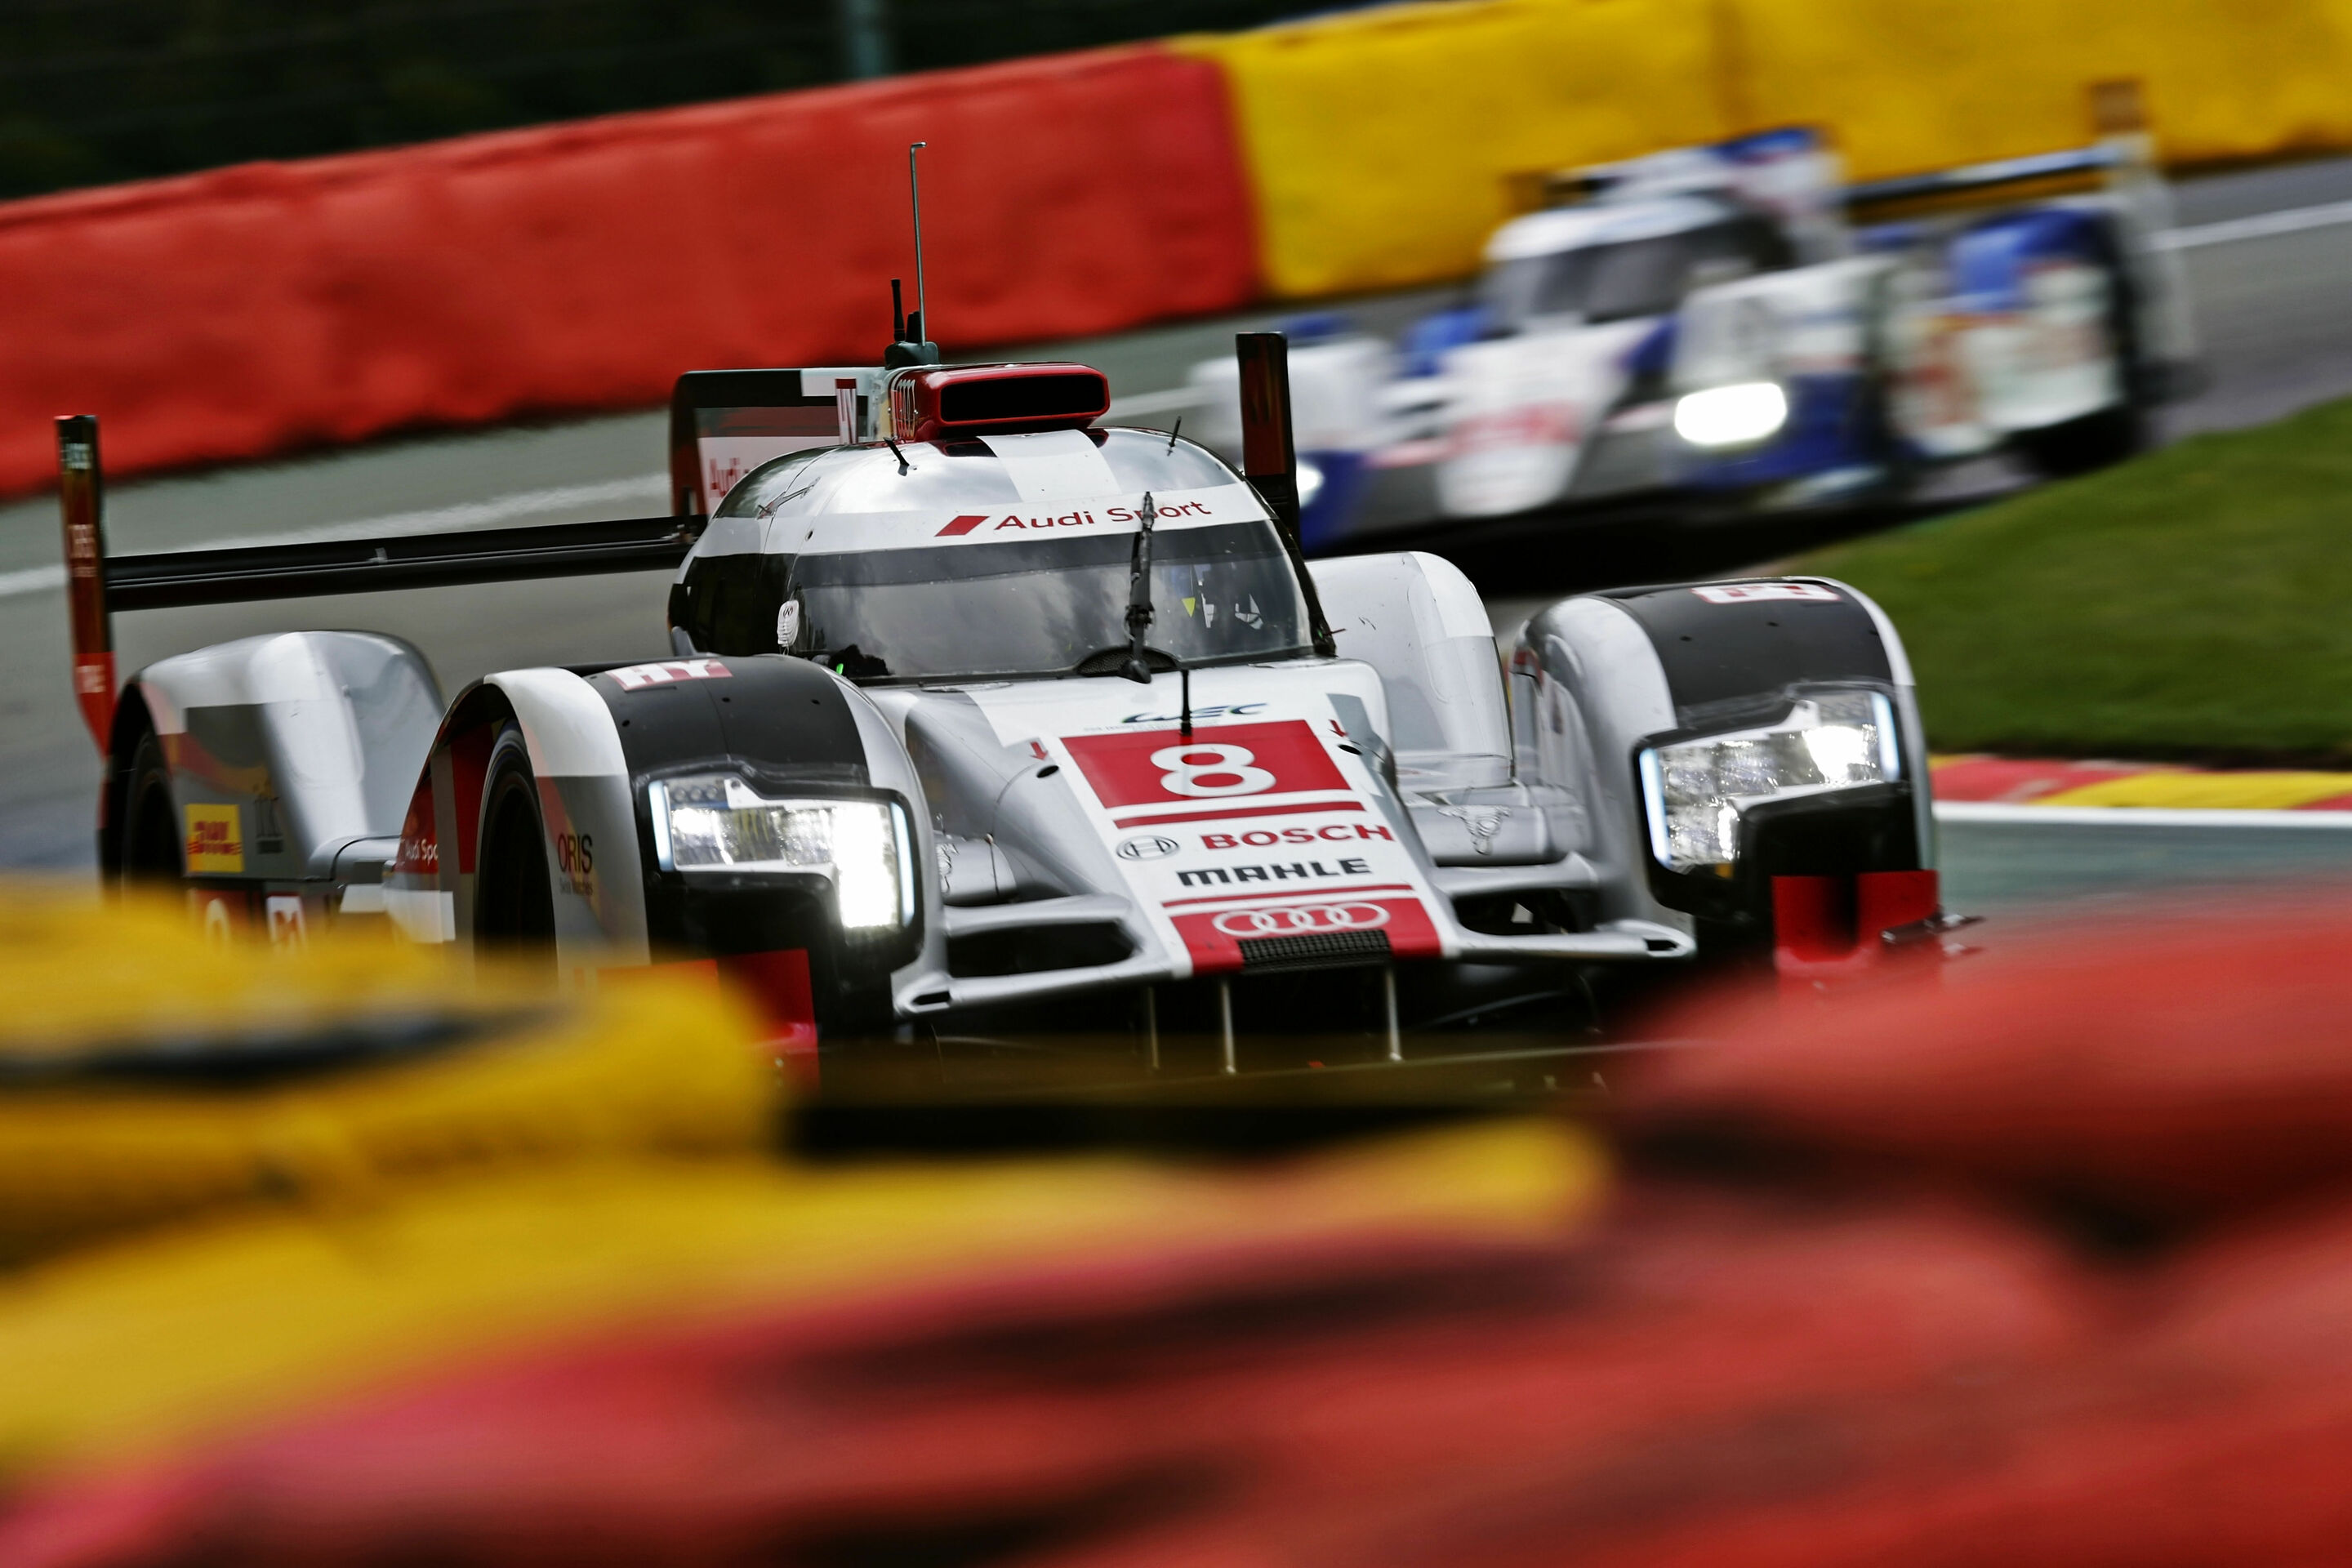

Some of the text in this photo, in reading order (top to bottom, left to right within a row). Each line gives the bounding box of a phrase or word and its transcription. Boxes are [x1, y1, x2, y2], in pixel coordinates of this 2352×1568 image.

[995, 510, 1095, 531] Audi
[1150, 743, 1276, 797] 8
[1201, 824, 1395, 849] BOSCH
[558, 832, 594, 875] ORIS
[1176, 858, 1373, 886] MAHLE
